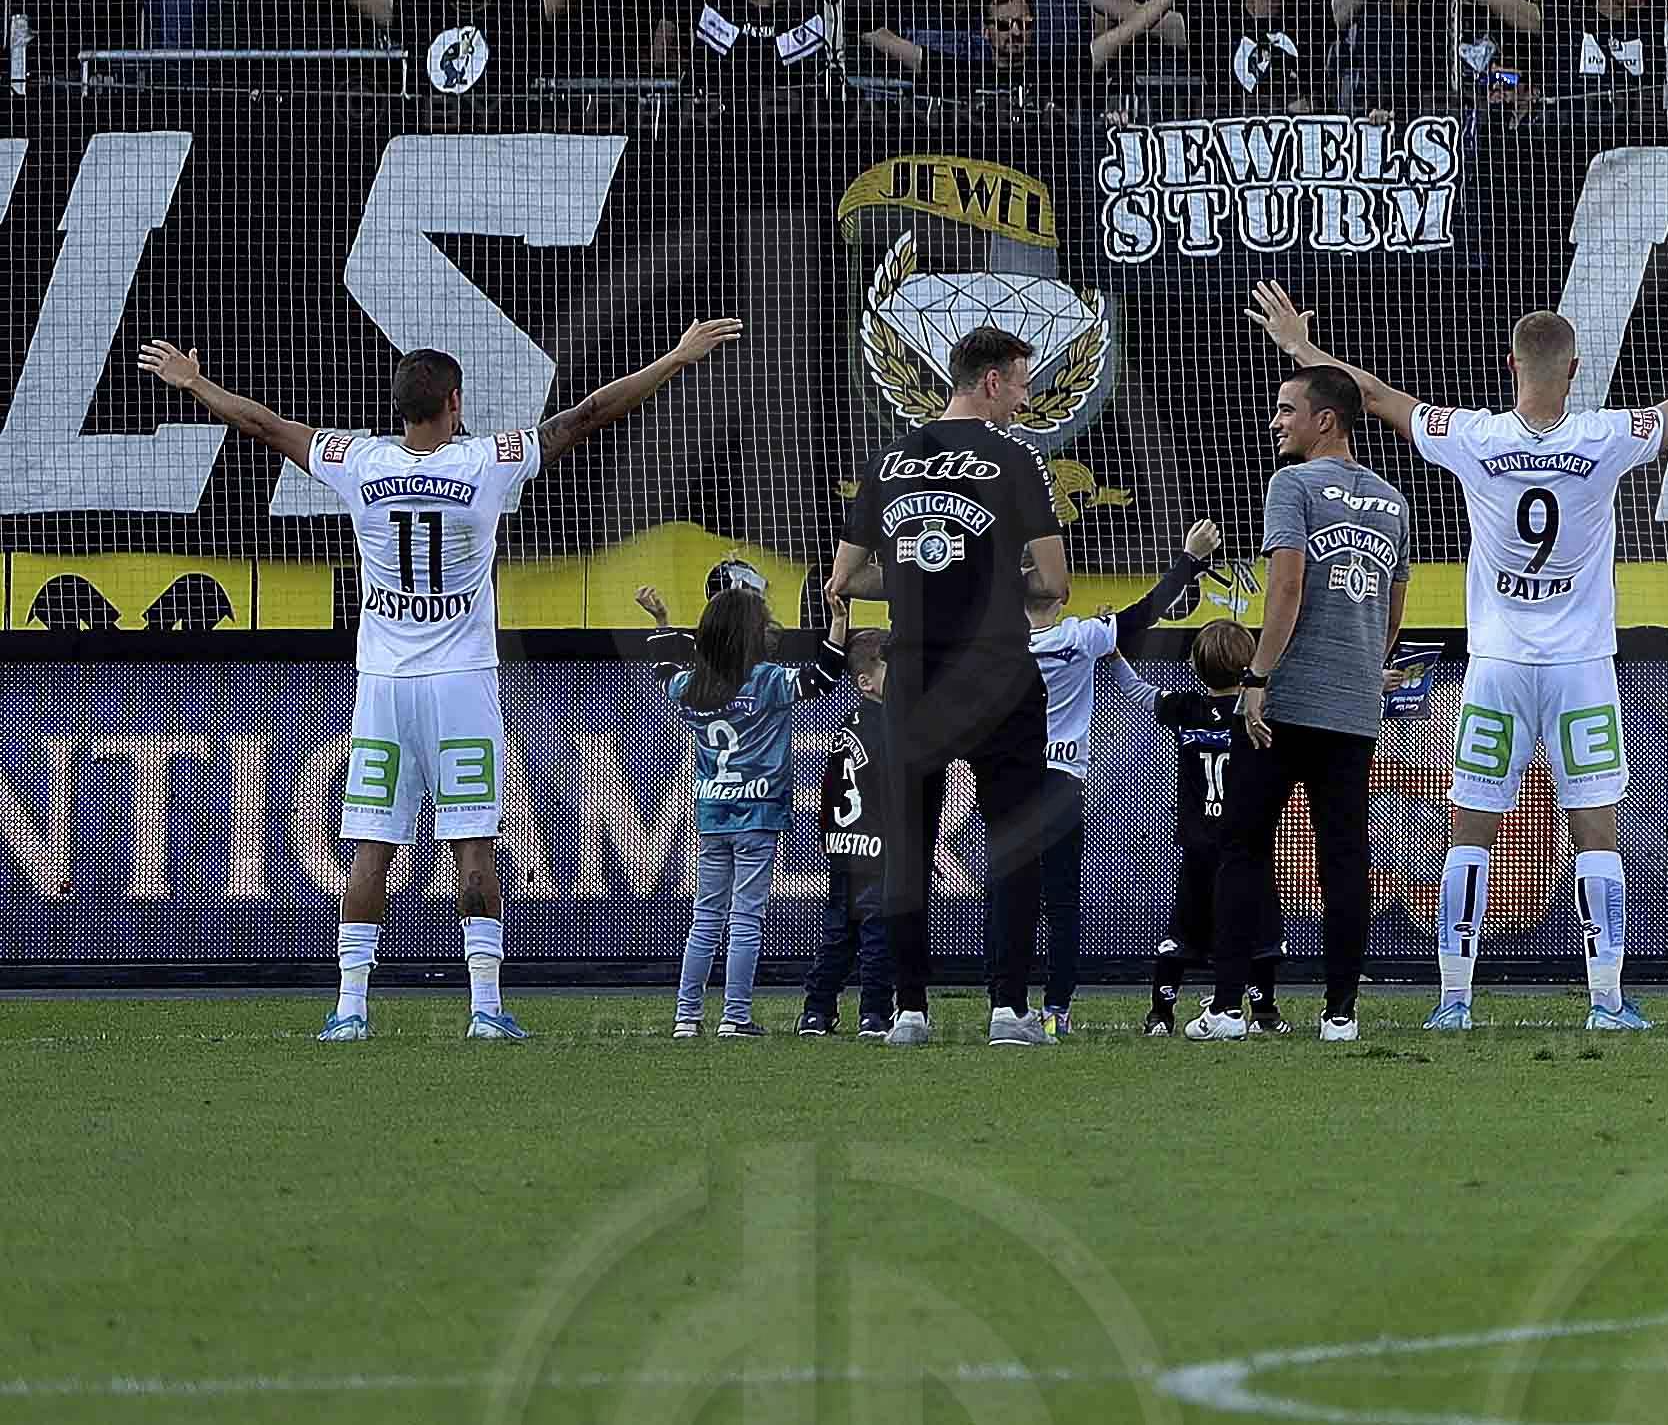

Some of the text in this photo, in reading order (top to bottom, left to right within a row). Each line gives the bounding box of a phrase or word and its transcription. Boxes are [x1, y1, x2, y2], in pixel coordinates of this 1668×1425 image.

[1098, 114, 1460, 191] JEWELS
[1100, 180, 1456, 263] STURM
[879, 450, 1001, 481] lotto
[1484, 451, 1597, 479] PUNTIGAMER
[361, 475, 477, 506] PUNTIGAMER
[882, 490, 996, 538] PUNTIGAMER
[1342, 492, 1402, 517] LOTTO
[389, 509, 446, 596] 11
[1308, 524, 1398, 569] PUNTIGAMER
[1516, 487, 1561, 575] 9
[364, 583, 479, 624] DESPODOV
[705, 719, 742, 783] 2
[832, 755, 863, 828] 3
